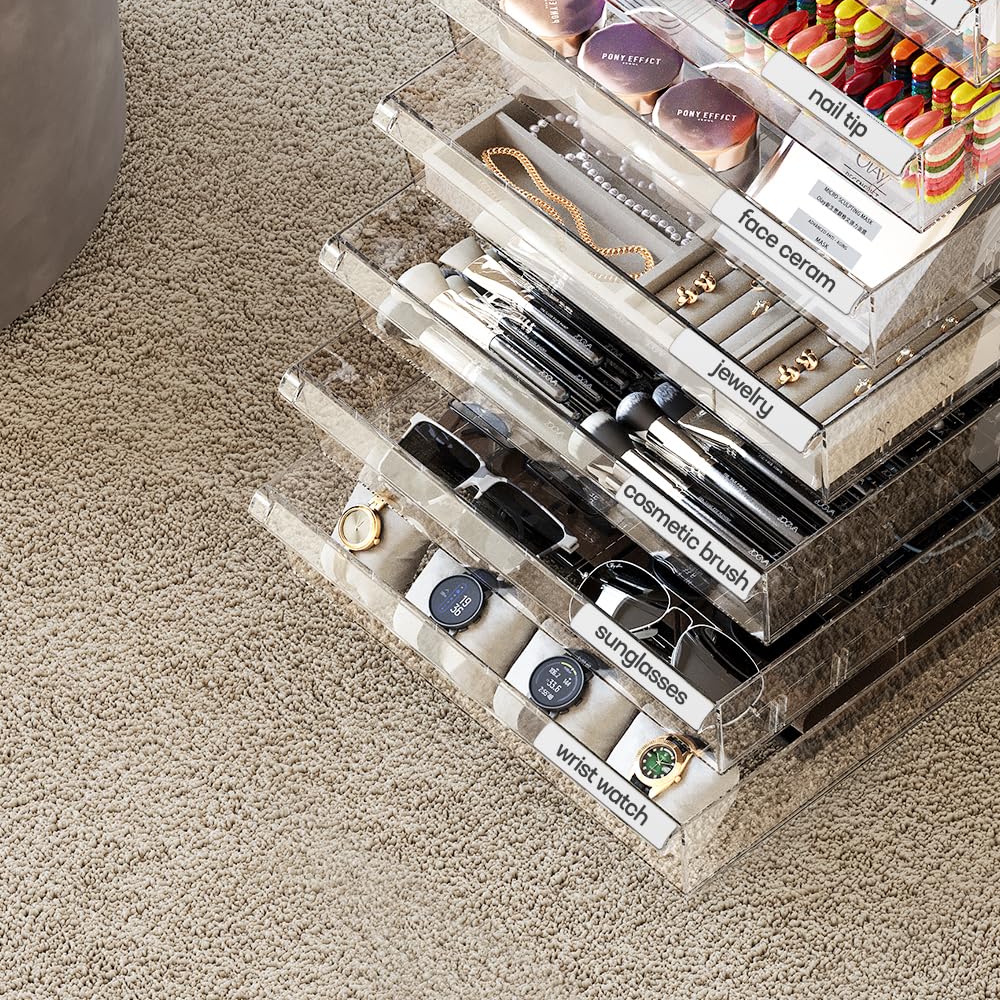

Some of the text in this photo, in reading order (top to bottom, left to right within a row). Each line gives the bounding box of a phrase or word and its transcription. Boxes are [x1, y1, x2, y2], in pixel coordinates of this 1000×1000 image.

[601, 52, 625, 62] PONY
[677, 109, 701, 119] PONY
[808, 88, 868, 138] nail tip
[738, 208, 836, 293] face ceram
[815, 236, 830, 250] MASK
[707, 359, 774, 420] jewelry
[623, 484, 700, 550] cosmetic
[698, 540, 764, 594] brush
[450, 602, 465, 617] 36
[460, 595, 472, 608] 19
[595, 625, 688, 705] sunglasses
[556, 743, 648, 826] wrist watch
